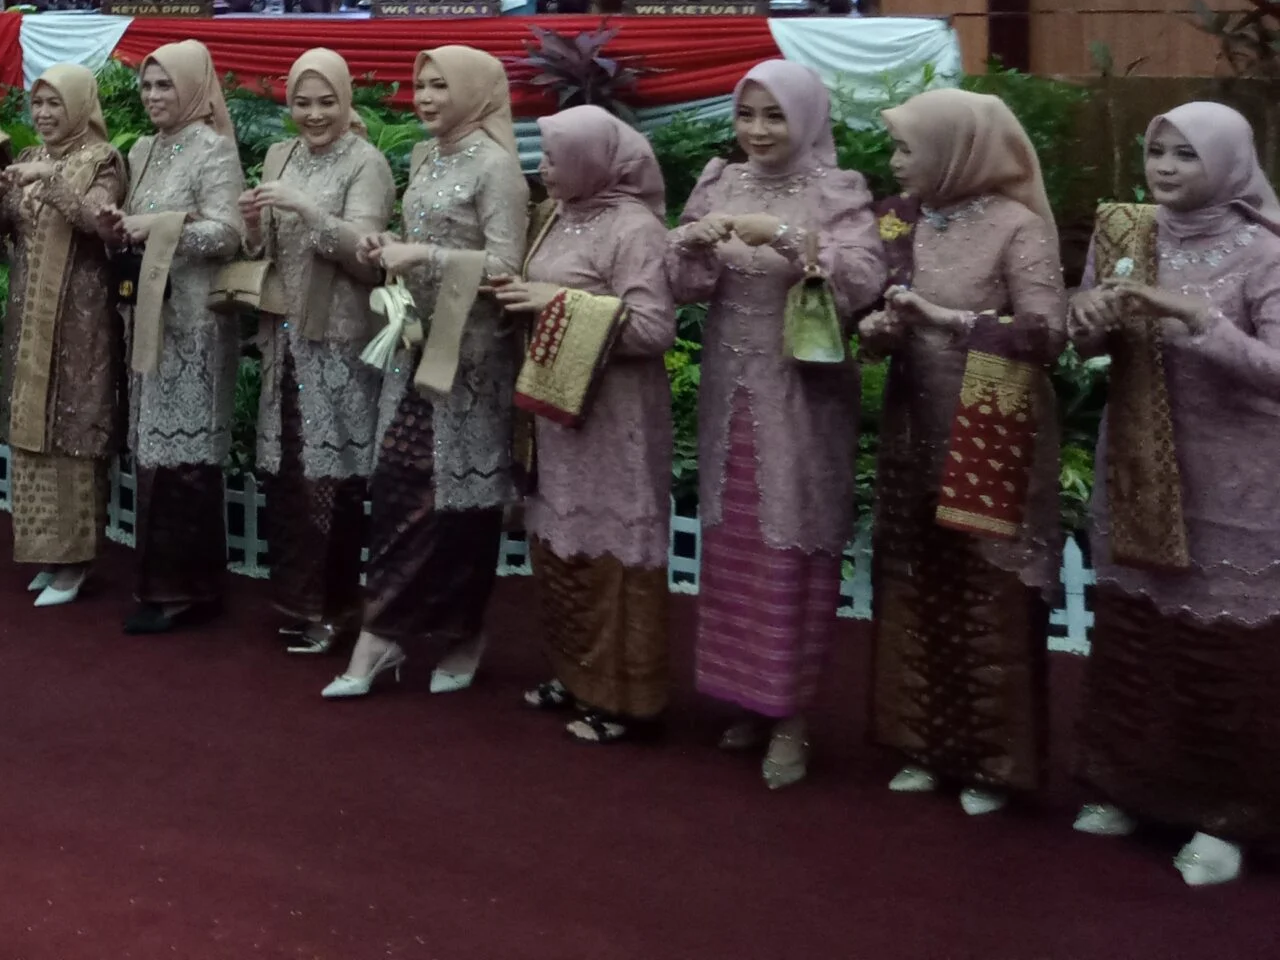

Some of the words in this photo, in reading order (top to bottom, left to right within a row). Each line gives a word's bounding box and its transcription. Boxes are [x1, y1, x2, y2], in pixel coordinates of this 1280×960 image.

[111, 5, 159, 14] KETUA
[162, 5, 200, 14] DPRD
[380, 5, 410, 14] WK
[414, 5, 479, 14] KETUA
[635, 5, 665, 14] WK
[669, 5, 736, 14] KETUA
